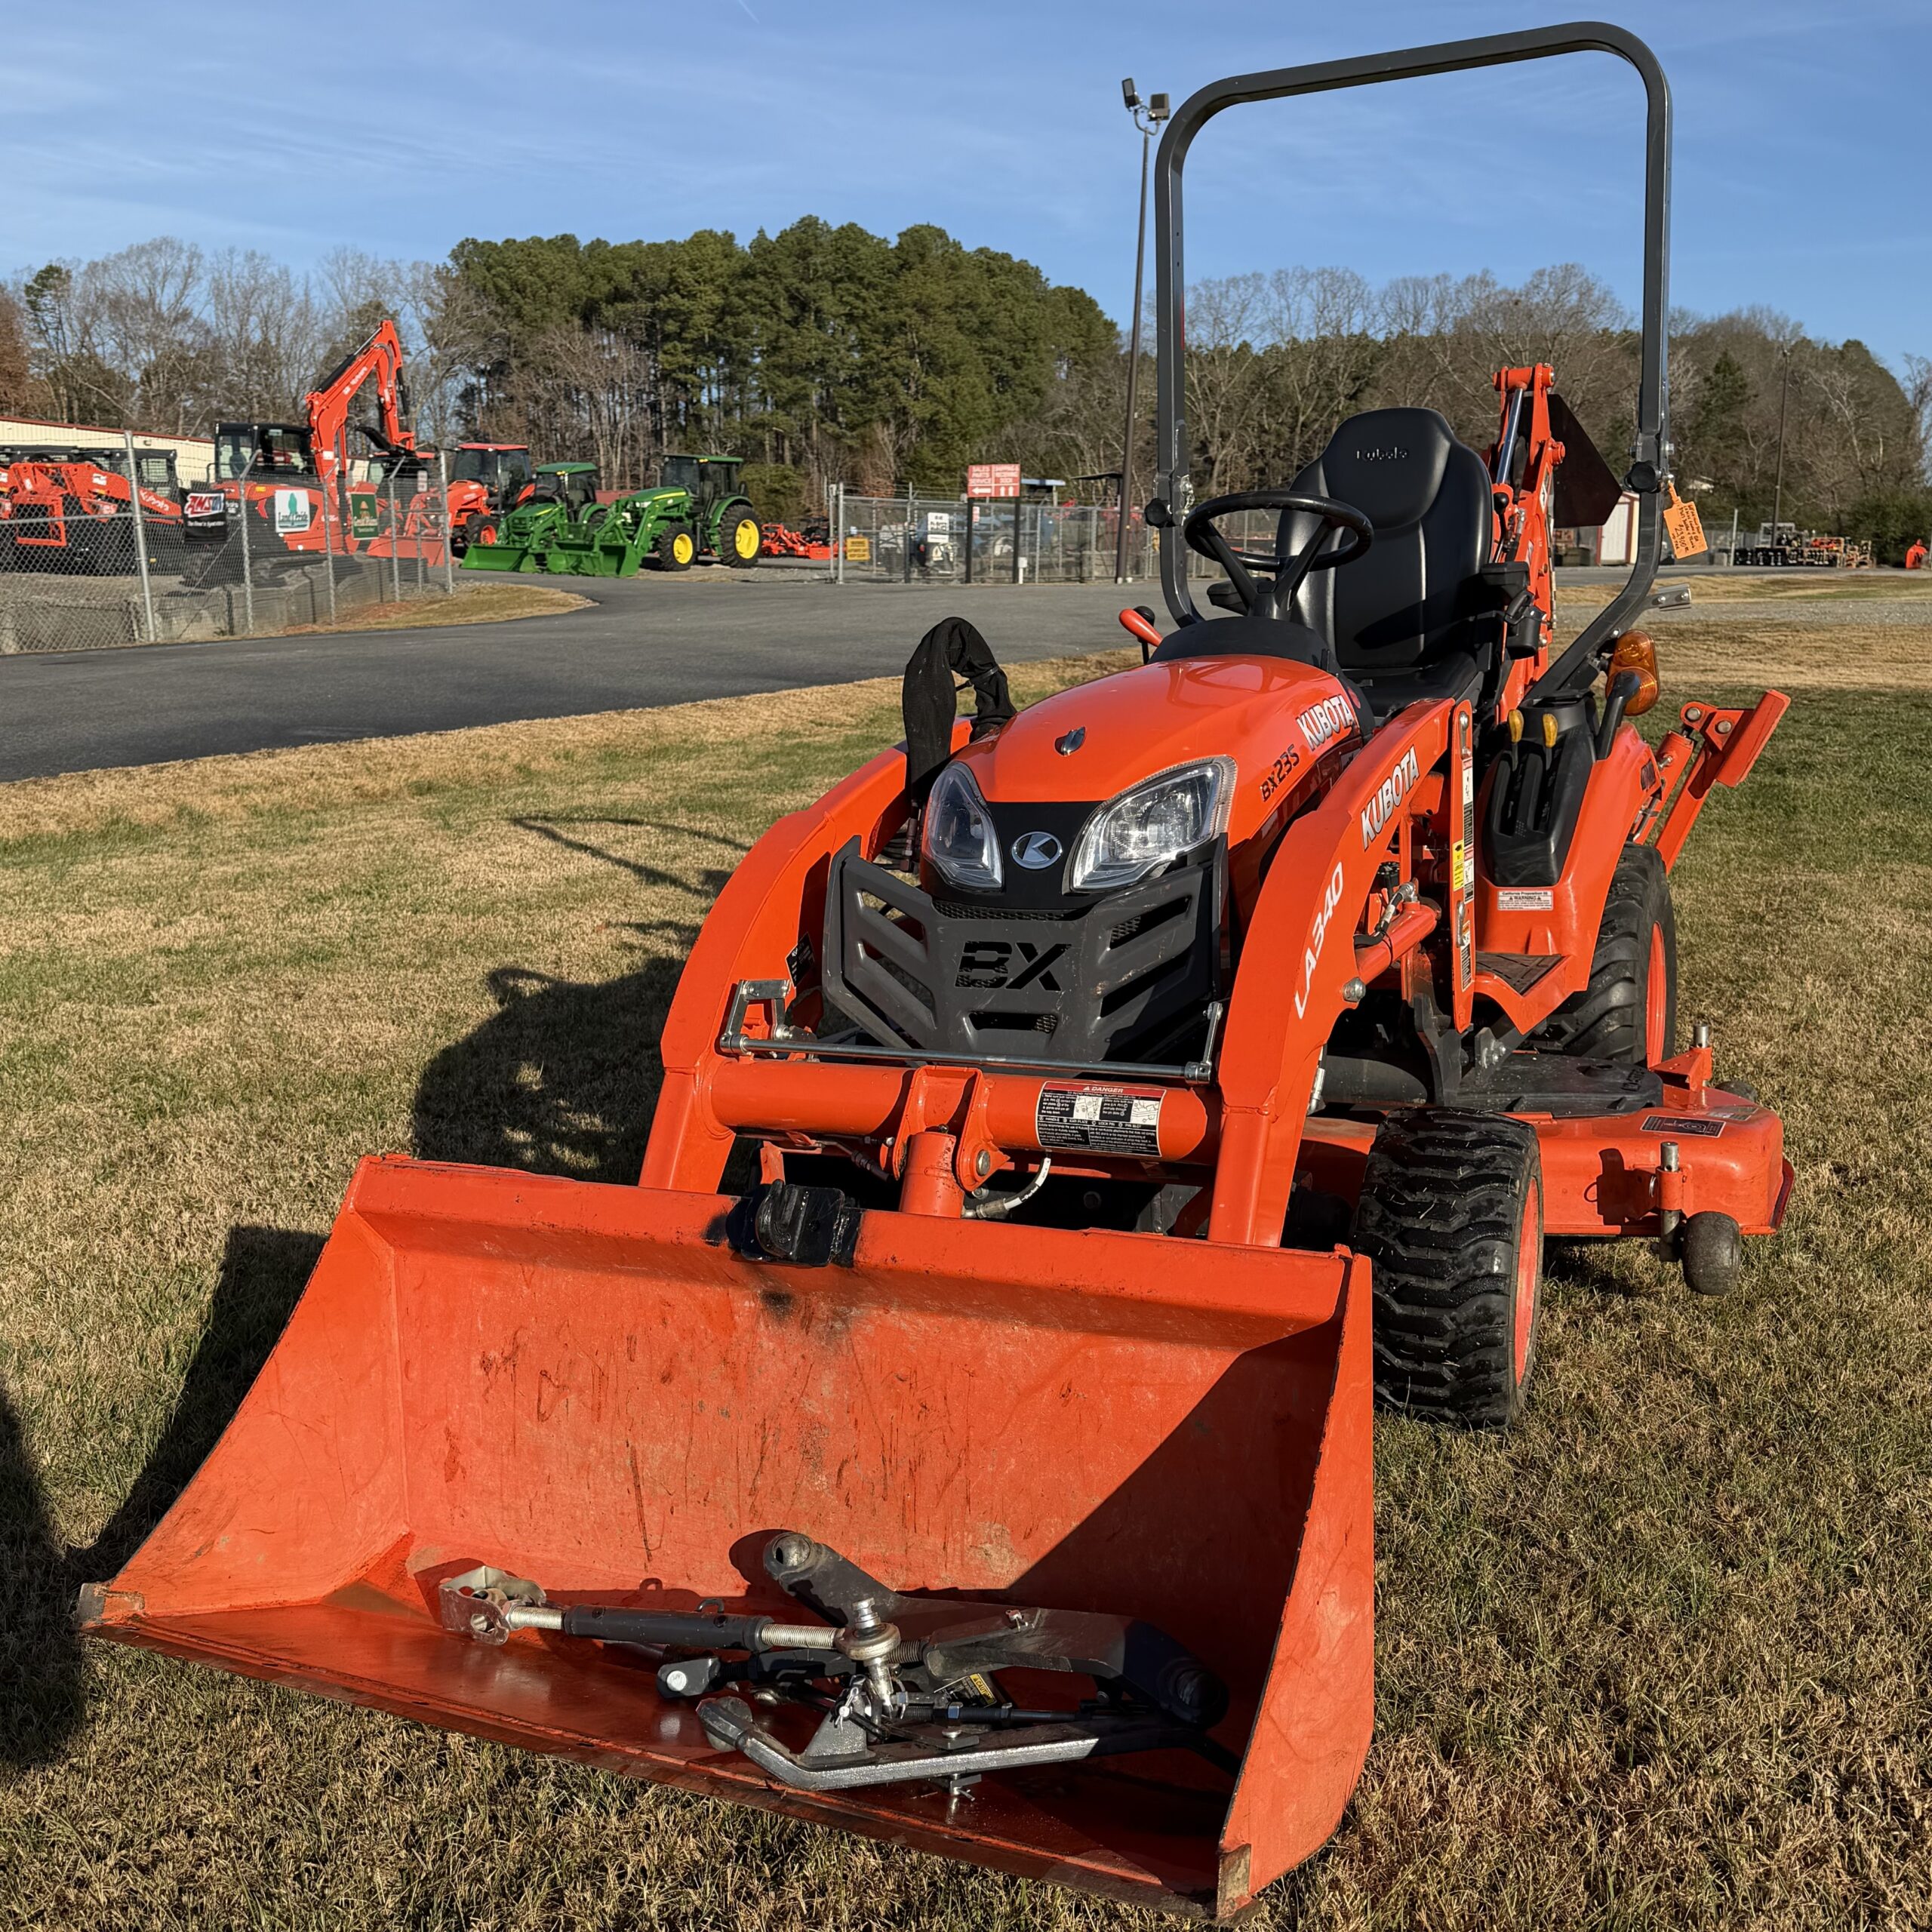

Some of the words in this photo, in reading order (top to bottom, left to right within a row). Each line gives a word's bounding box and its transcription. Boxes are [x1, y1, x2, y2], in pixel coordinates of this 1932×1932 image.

[1296, 694, 1355, 752] KUBOTA
[1260, 744, 1300, 801] BX23S
[1361, 744, 1420, 853] KUBOTA
[955, 941, 1072, 991] BX
[1294, 861, 1343, 1020] LA340
